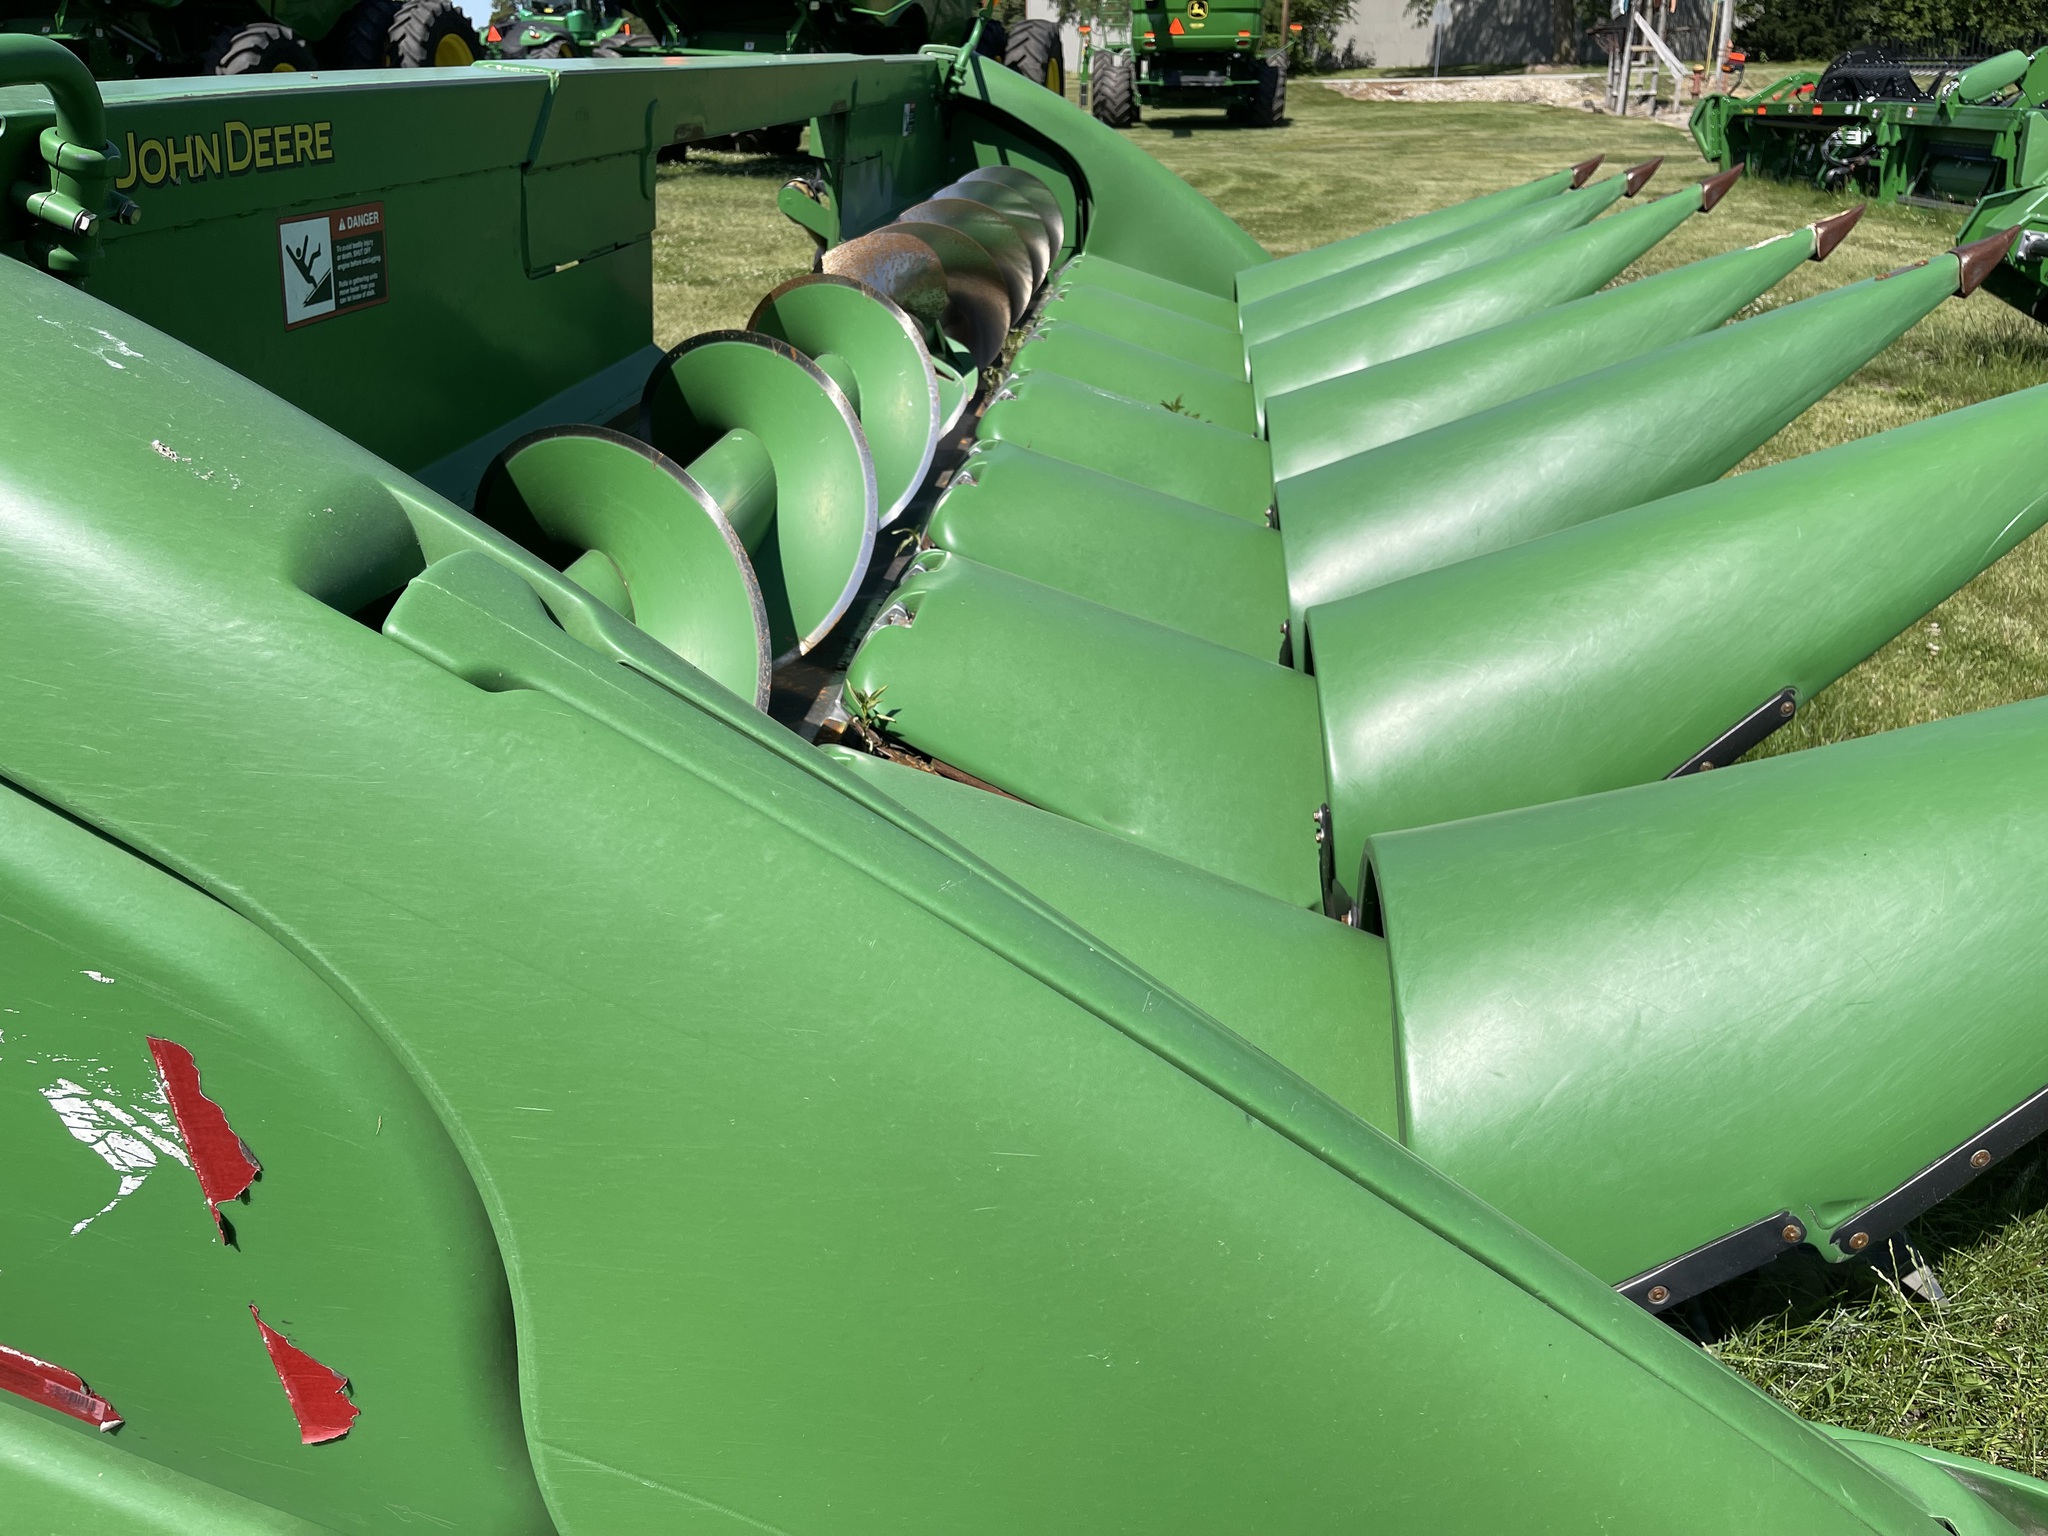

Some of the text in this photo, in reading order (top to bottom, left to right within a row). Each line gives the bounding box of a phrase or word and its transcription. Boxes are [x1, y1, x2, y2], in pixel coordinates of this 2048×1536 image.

[115, 121, 333, 189] JOHN DEERE
[347, 211, 380, 229] DANGER
